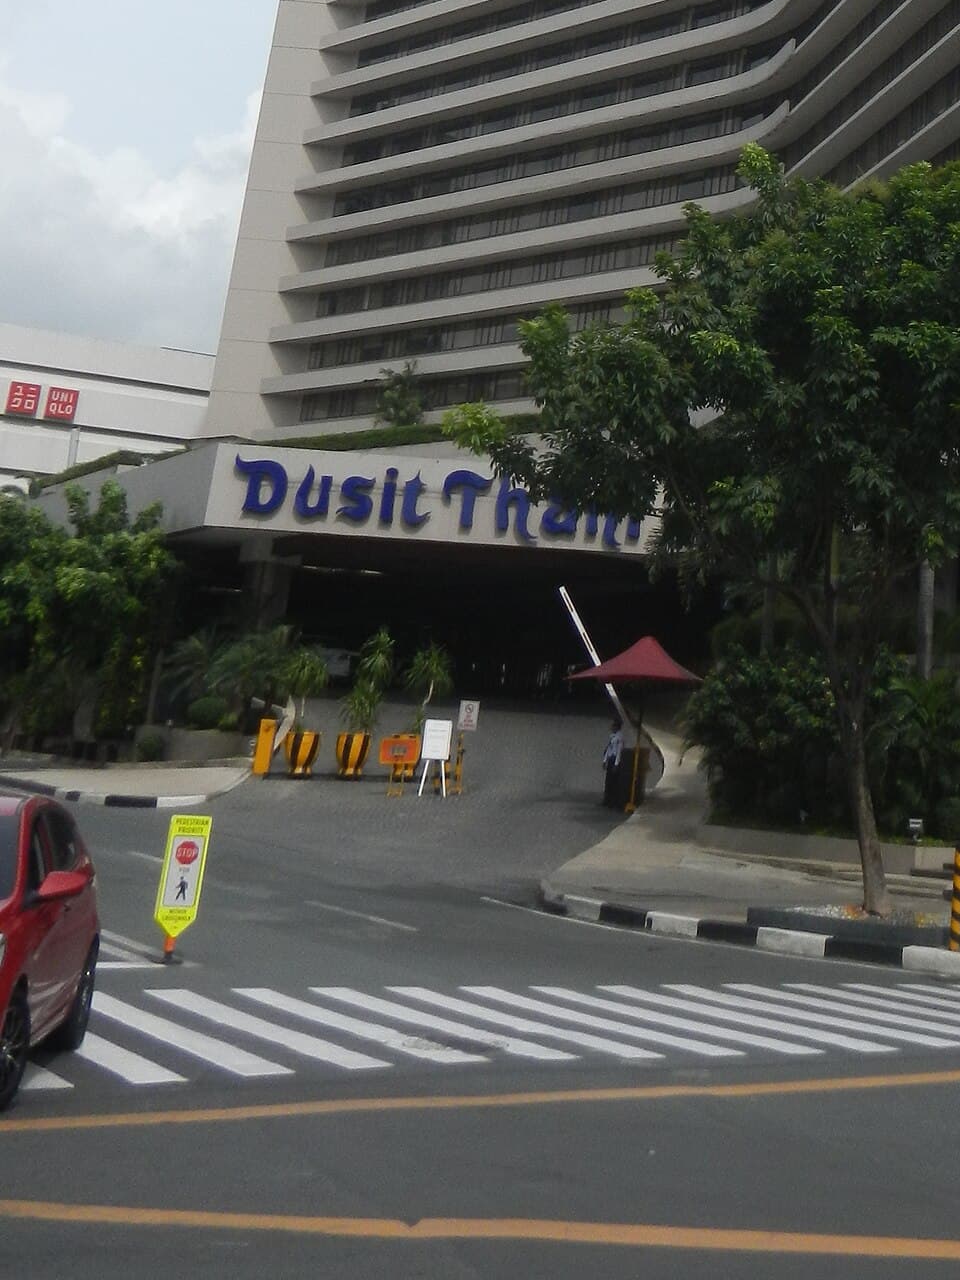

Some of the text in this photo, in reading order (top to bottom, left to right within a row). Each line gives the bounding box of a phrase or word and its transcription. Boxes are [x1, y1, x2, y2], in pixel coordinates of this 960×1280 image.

[51, 391, 74, 402] UNI
[49, 404, 73, 415] QLO
[235, 453, 432, 527] Dusit
[176, 847, 197, 857] STOP
